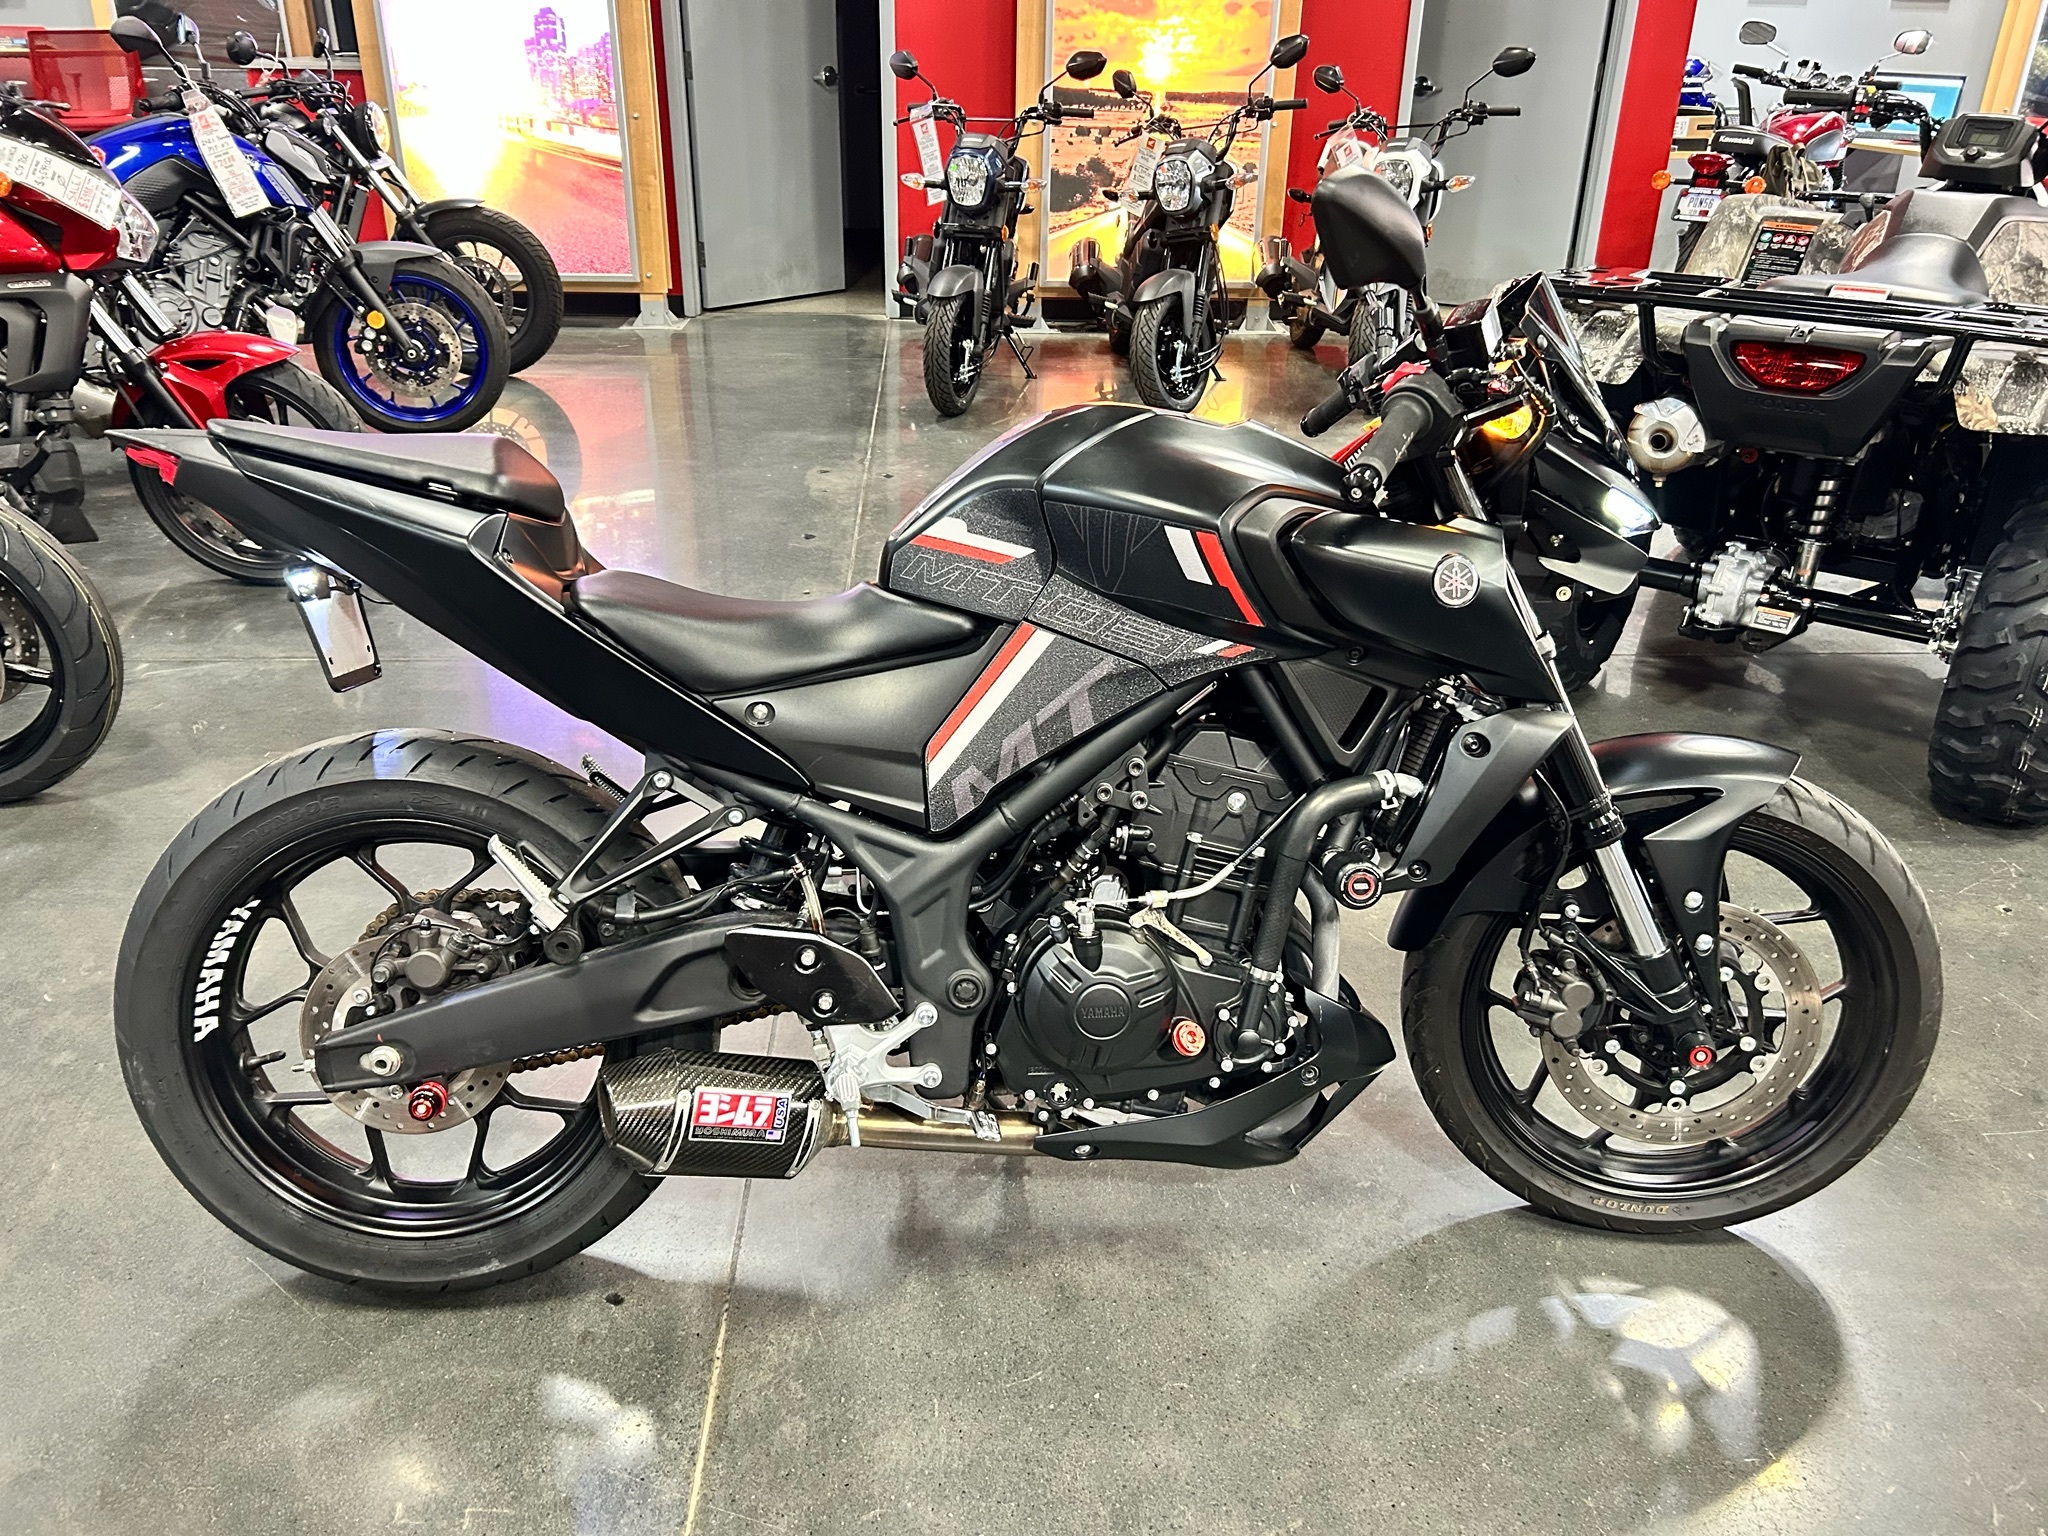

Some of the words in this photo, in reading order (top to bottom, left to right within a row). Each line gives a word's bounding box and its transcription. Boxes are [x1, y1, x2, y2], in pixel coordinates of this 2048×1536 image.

[1719, 135, 1755, 145] Kawasaki
[951, 655, 1117, 821] MT
[193, 899, 262, 1043] YAMAHA
[1080, 1006, 1126, 1019] YAMAHA
[698, 1092, 773, 1127] ヨシムラ
[774, 1098, 788, 1128] USA
[694, 1126, 766, 1138] YOSHIMURA
[1592, 1197, 1670, 1216] DUNLOP
